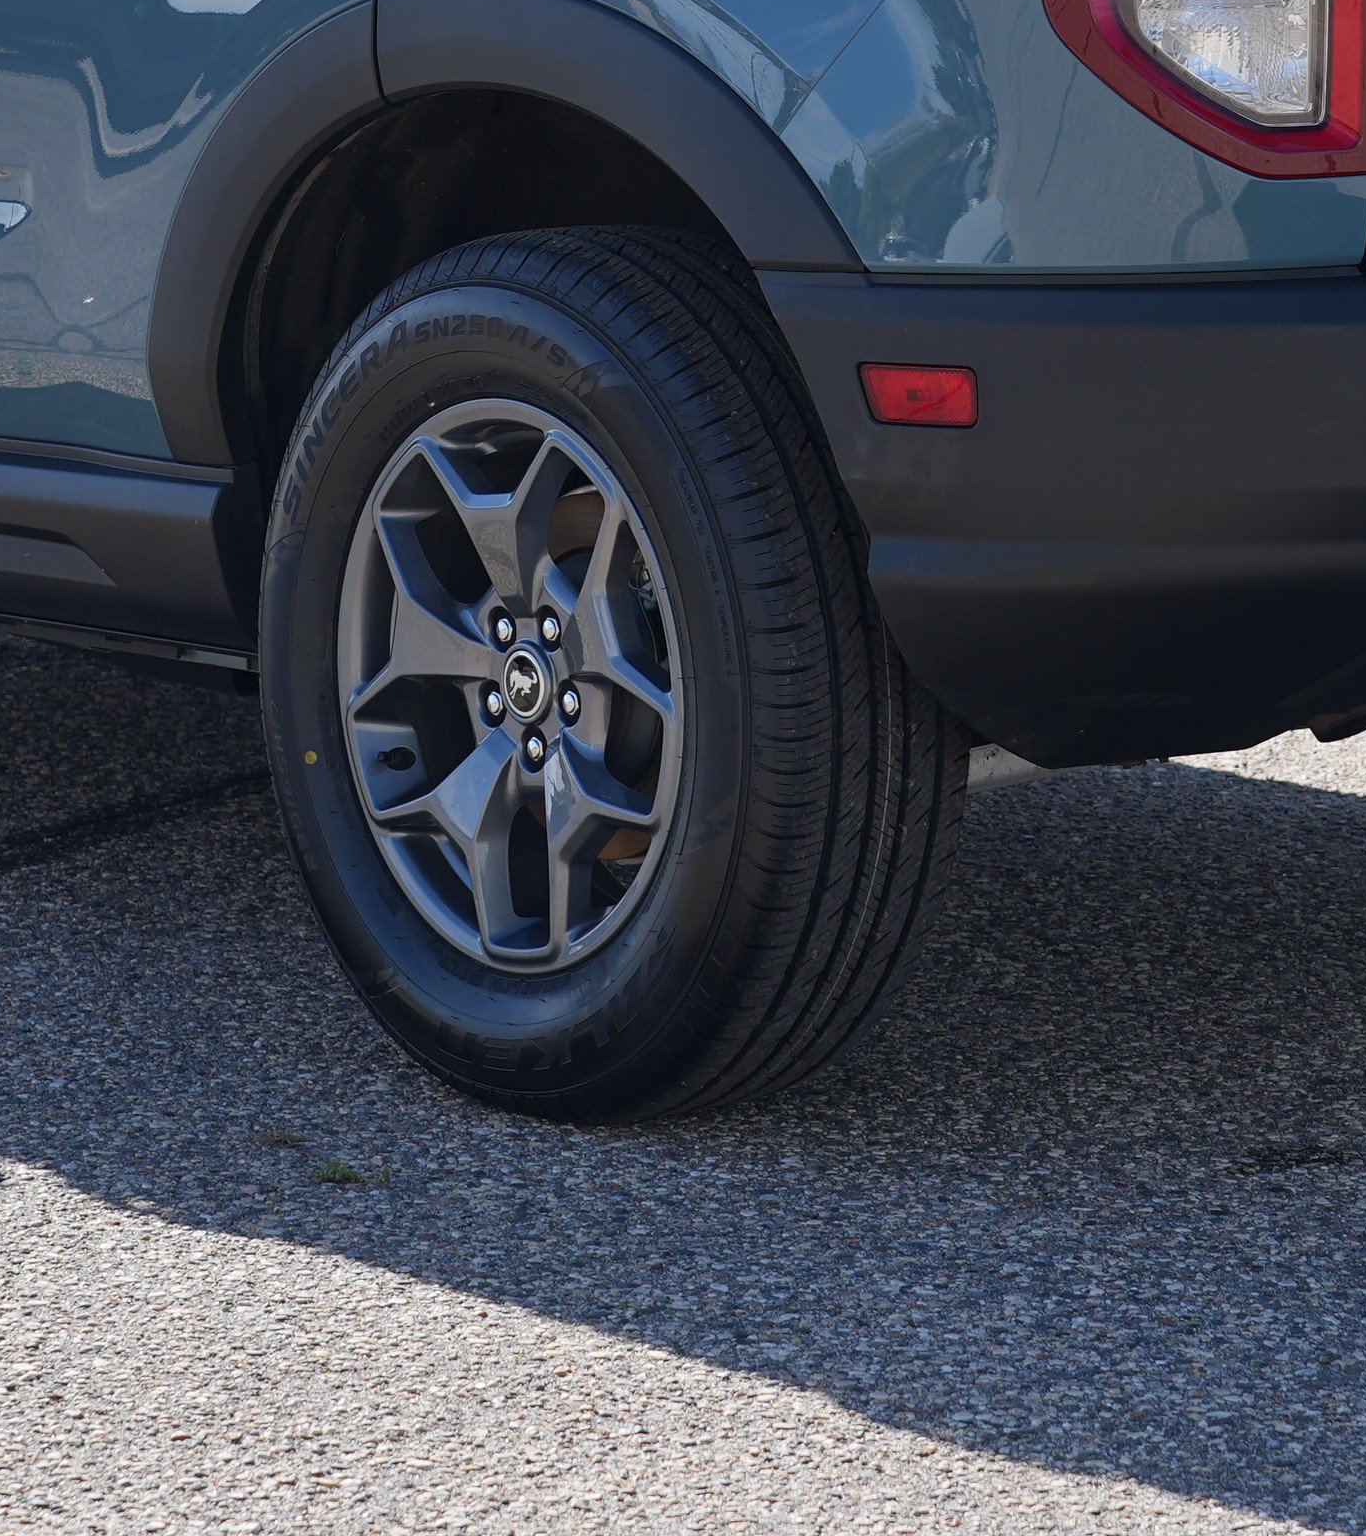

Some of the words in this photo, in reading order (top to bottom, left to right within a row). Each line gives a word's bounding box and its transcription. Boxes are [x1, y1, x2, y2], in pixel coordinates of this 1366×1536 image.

[282, 319, 409, 526] SINCERA
[413, 315, 504, 345] SN250
[508, 325, 568, 368] A/S
